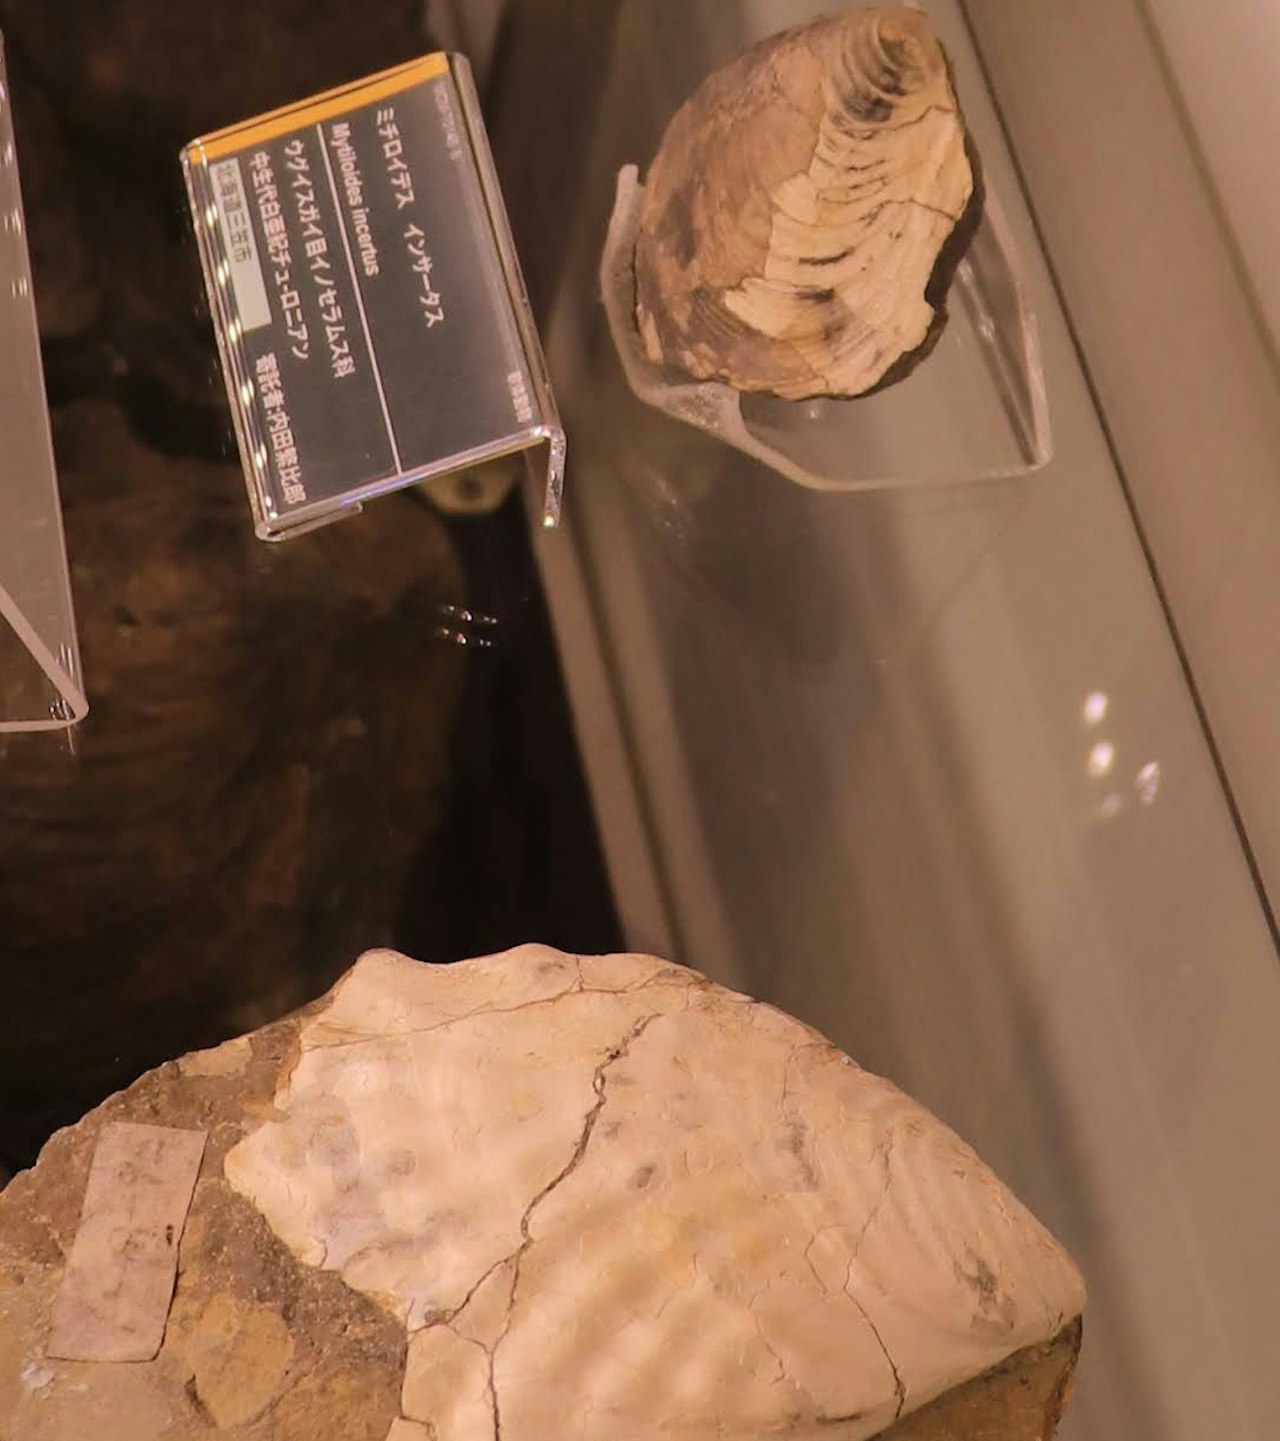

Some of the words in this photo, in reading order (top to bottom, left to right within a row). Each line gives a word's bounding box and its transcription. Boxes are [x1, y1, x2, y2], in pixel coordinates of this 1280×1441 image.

[281, 139, 357, 380] ウグイスガイ目イノセラムス科
[330, 121, 366, 208] Mytiloides
[352, 207, 382, 278] incertus
[374, 105, 416, 210] ミチロイデス
[403, 221, 446, 330] インサータス
